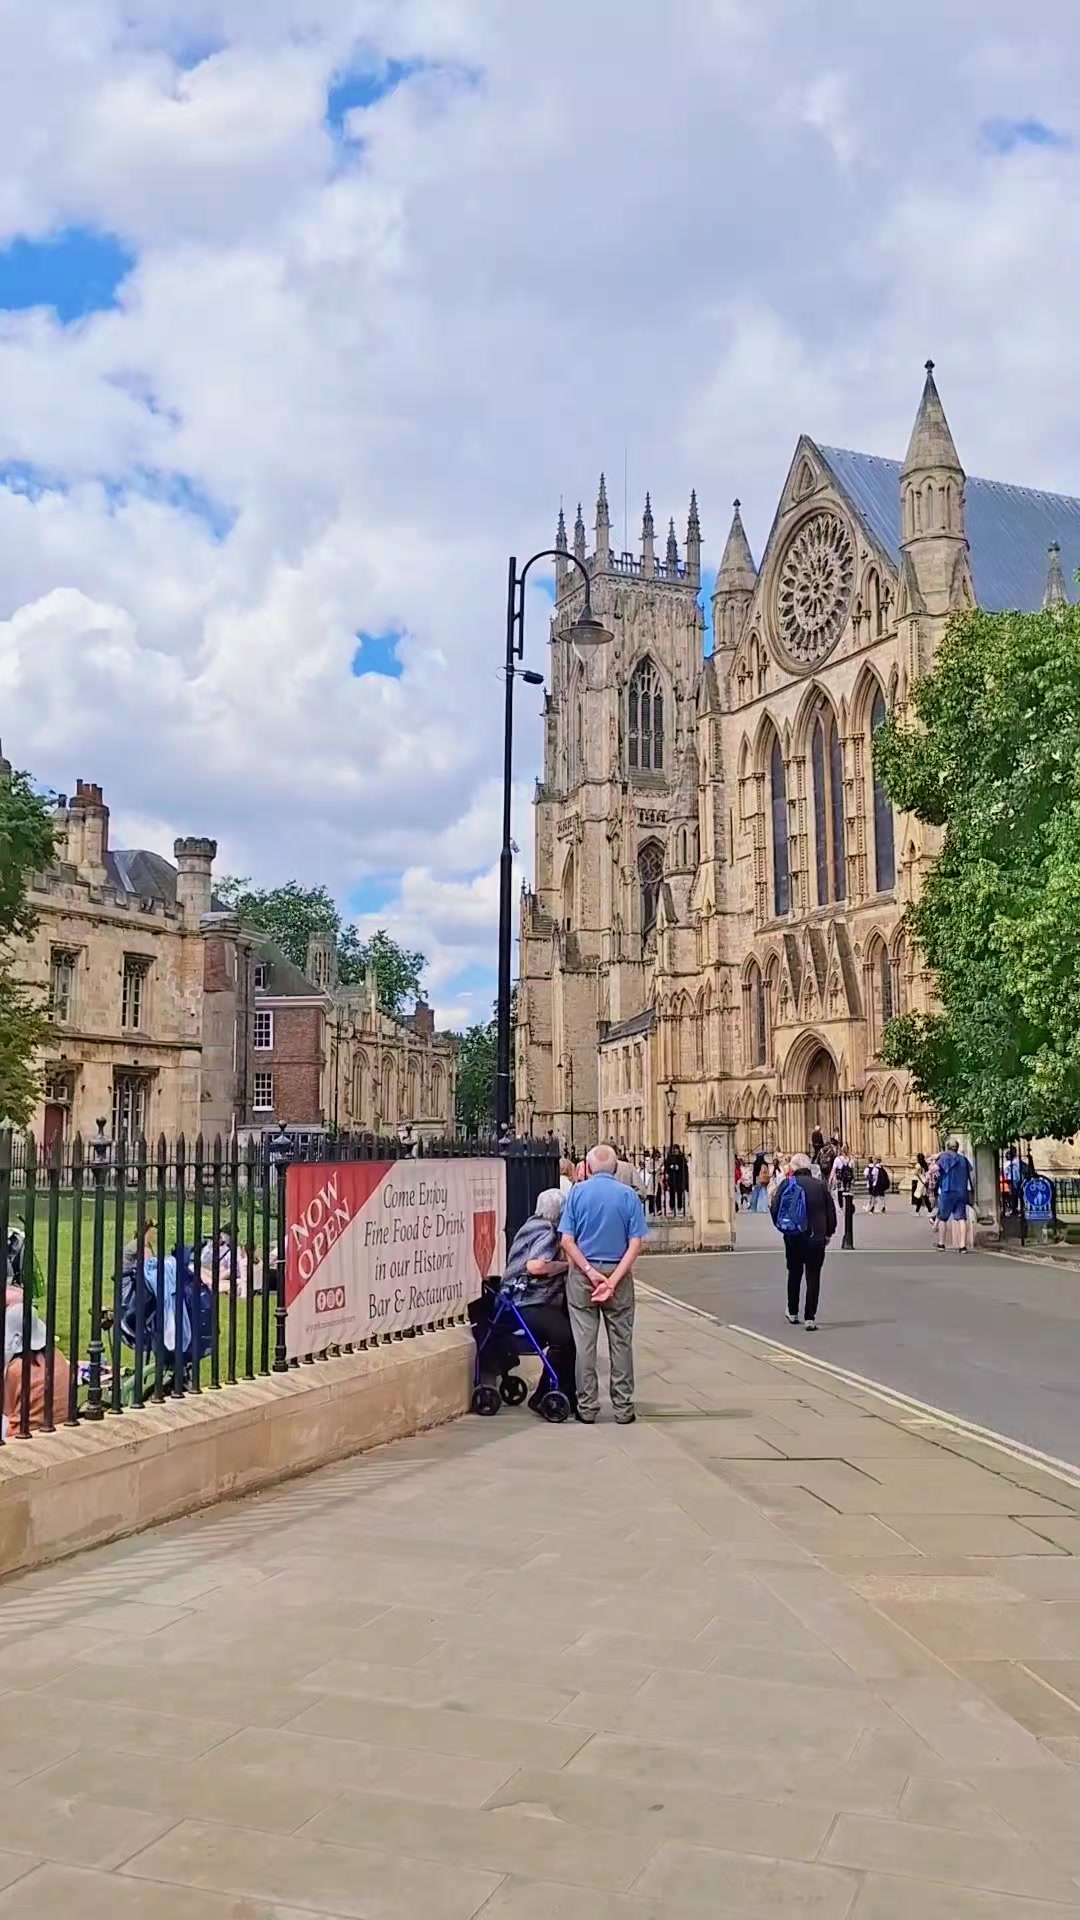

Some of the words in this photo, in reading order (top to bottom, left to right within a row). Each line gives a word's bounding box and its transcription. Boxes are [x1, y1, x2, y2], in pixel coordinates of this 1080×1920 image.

[290, 1170, 340, 1250] NOW
[383, 1184, 415, 1209] Come
[419, 1181, 448, 1211] Enjoy
[297, 1197, 351, 1280] OPEN
[364, 1220, 389, 1247] Fine
[392, 1216, 419, 1243] Food
[423, 1217, 433, 1239] &
[435, 1211, 466, 1238] Drink
[375, 1256, 387, 1281] in
[389, 1258, 409, 1278] our
[414, 1246, 455, 1274] Historic
[369, 1293, 390, 1319] Bar
[394, 1289, 406, 1313] &
[408, 1281, 464, 1310] Restaurant
